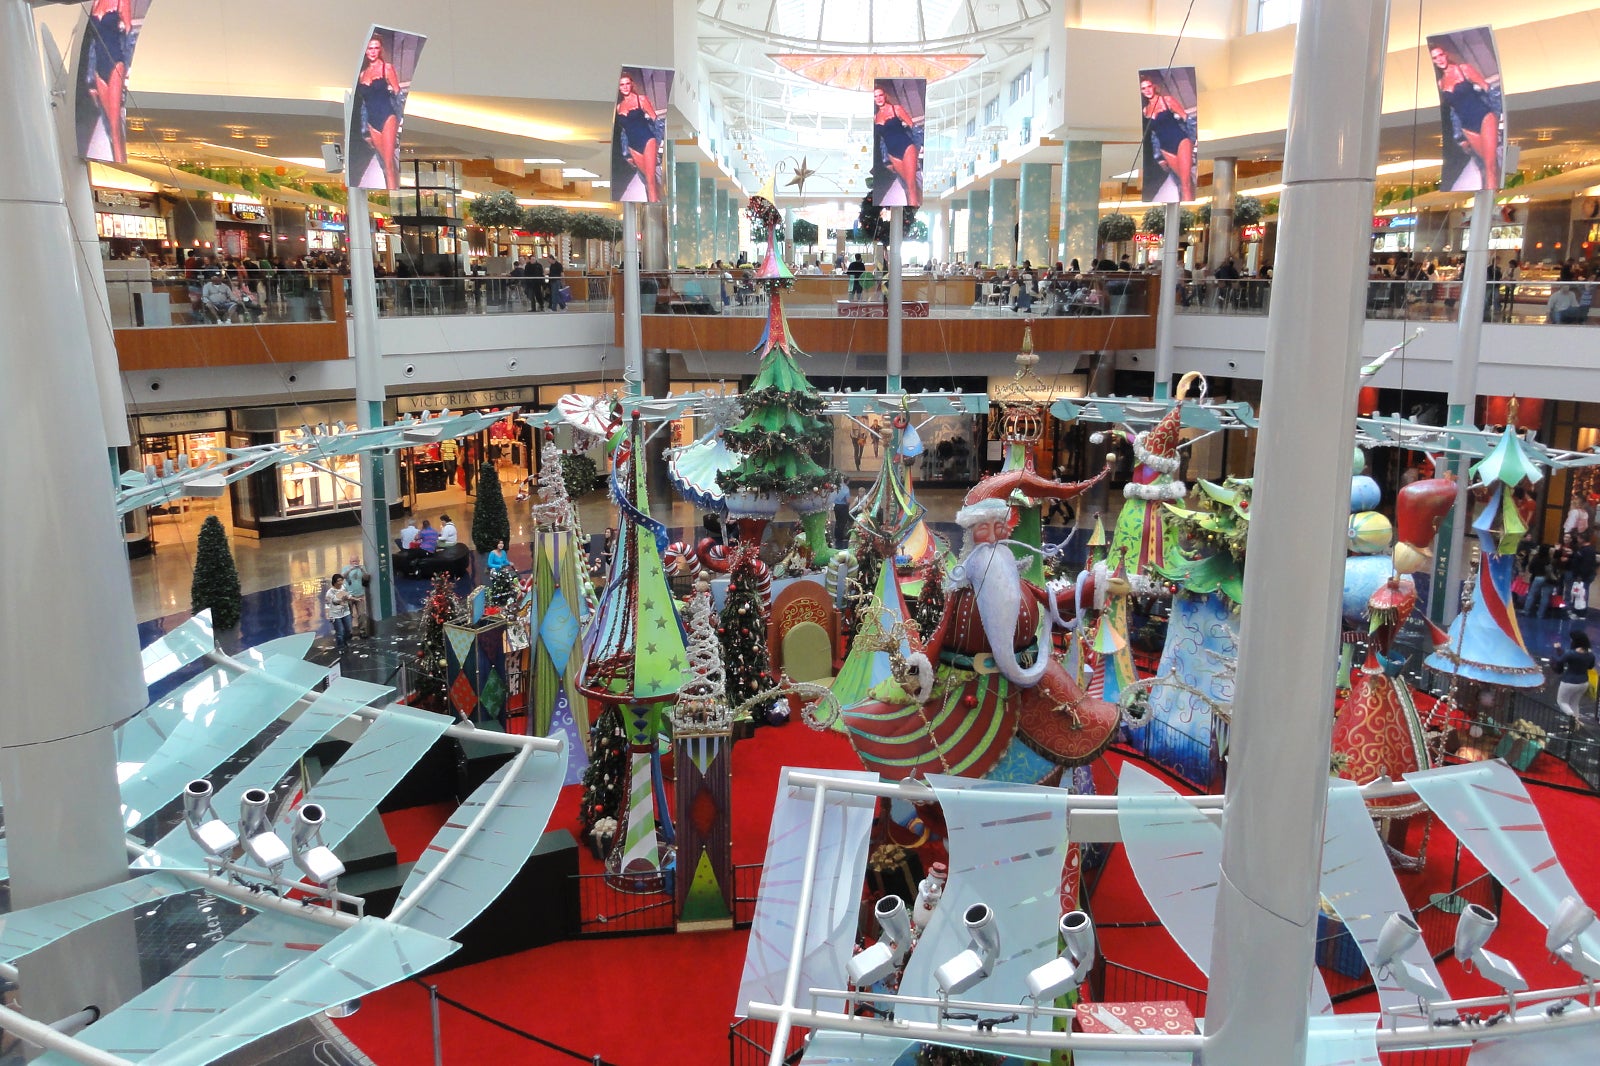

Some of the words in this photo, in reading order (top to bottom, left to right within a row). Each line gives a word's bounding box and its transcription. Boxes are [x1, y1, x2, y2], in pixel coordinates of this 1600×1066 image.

[231, 203, 265, 217] FIREHOUSE
[242, 212, 256, 220] SUBS
[483, 389, 523, 403] SECRET
